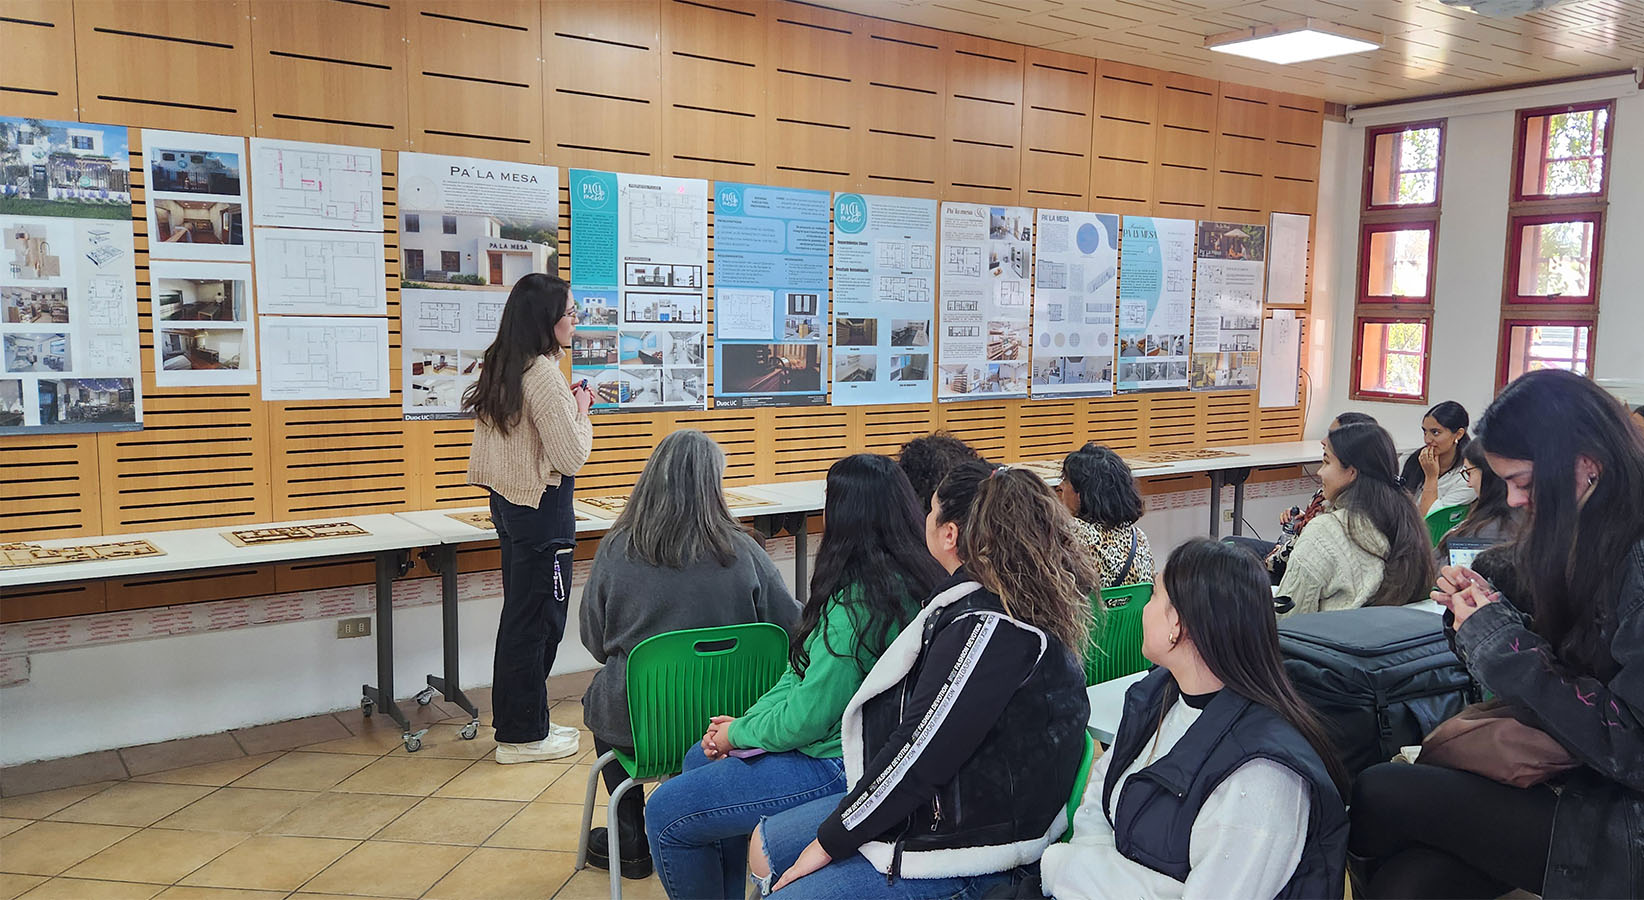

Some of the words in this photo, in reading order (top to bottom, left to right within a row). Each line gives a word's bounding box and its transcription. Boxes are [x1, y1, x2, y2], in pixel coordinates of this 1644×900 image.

[500, 172, 538, 184] MESA
[1140, 230, 1158, 239] MESA
[952, 645, 970, 670] FASHION
[965, 622, 982, 647] DEVOTION
[953, 658, 972, 686] DEVOTION
[916, 707, 934, 731] FASHION
[930, 682, 950, 710] DEVOTION
[914, 720, 935, 748] DEVOTION
[874, 763, 894, 785] FASHION
[889, 741, 912, 767] DEVOTION
[872, 776, 893, 799] DEVOTION
